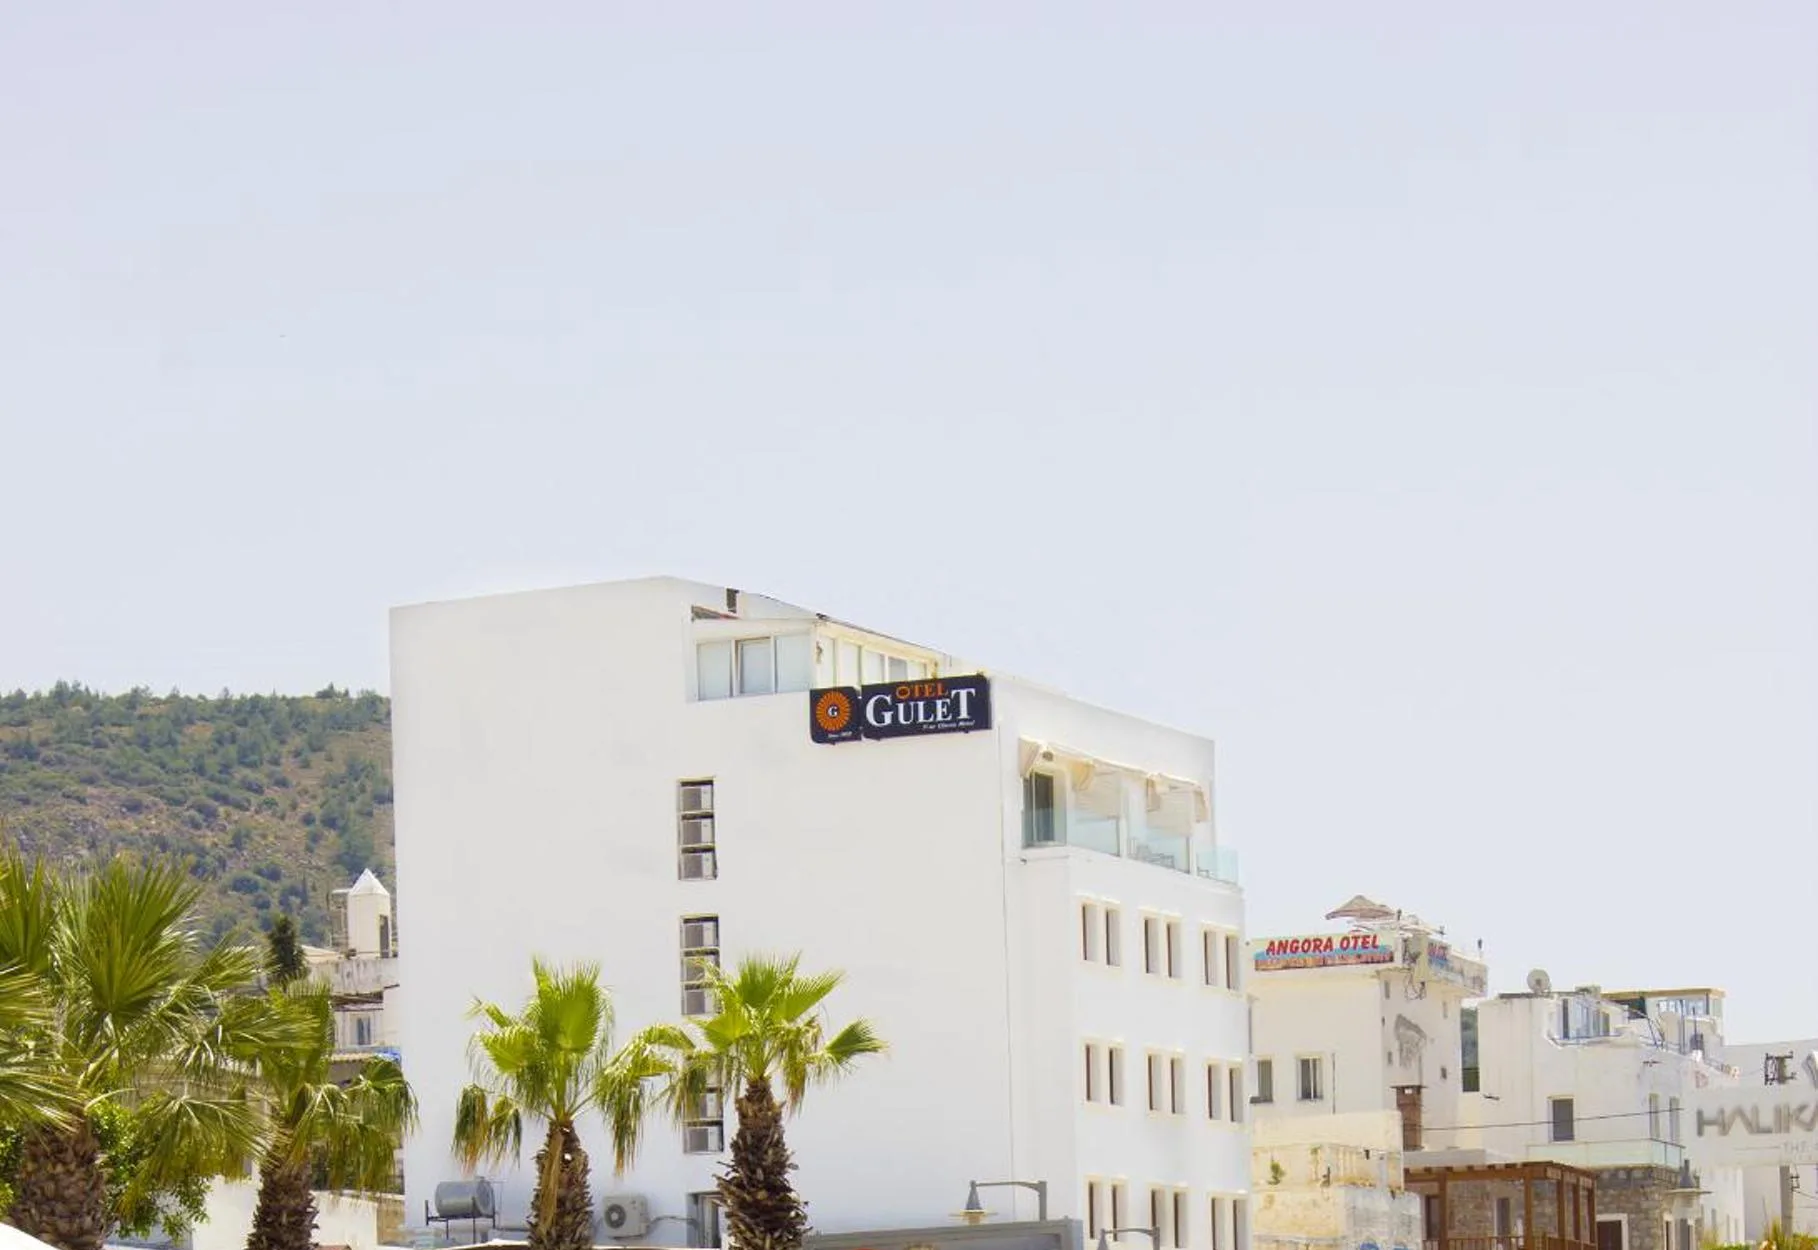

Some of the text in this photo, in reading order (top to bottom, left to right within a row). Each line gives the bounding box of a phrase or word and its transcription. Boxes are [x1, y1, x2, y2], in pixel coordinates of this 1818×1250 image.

[896, 682, 949, 699] OTEL
[828, 705, 838, 717] G
[866, 688, 976, 726] GULET
[1266, 933, 1380, 956] ANGORA OTEL
